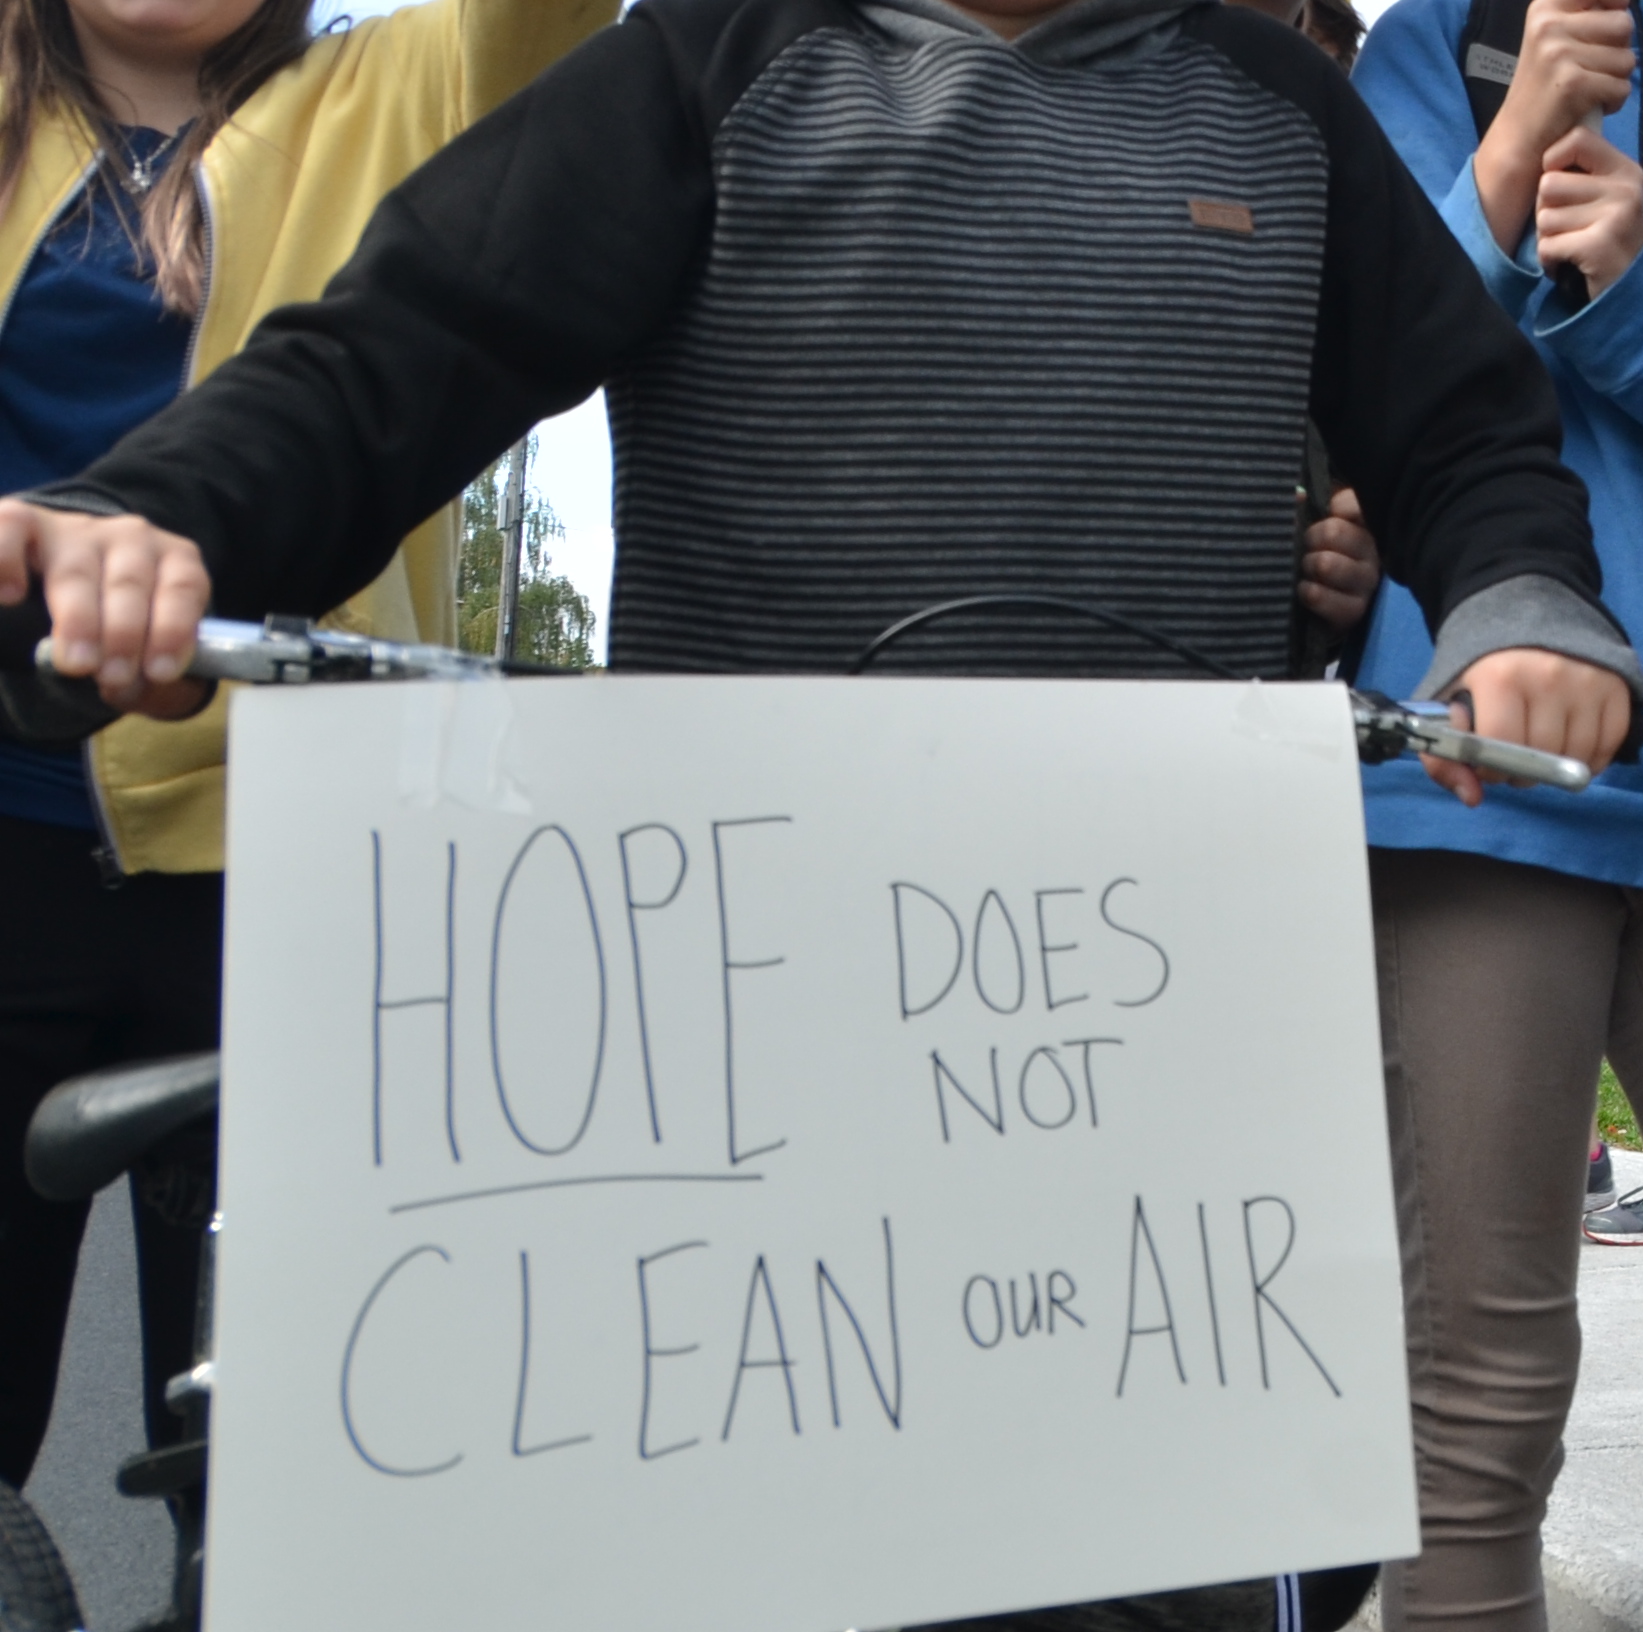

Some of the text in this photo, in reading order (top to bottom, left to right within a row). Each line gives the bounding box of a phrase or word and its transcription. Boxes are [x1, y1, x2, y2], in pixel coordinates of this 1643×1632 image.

[369, 814, 1171, 1166] HOPE DOES
[929, 1037, 1125, 1145] NOT
[340, 1193, 1343, 1479] CLEAN OUR AIR
